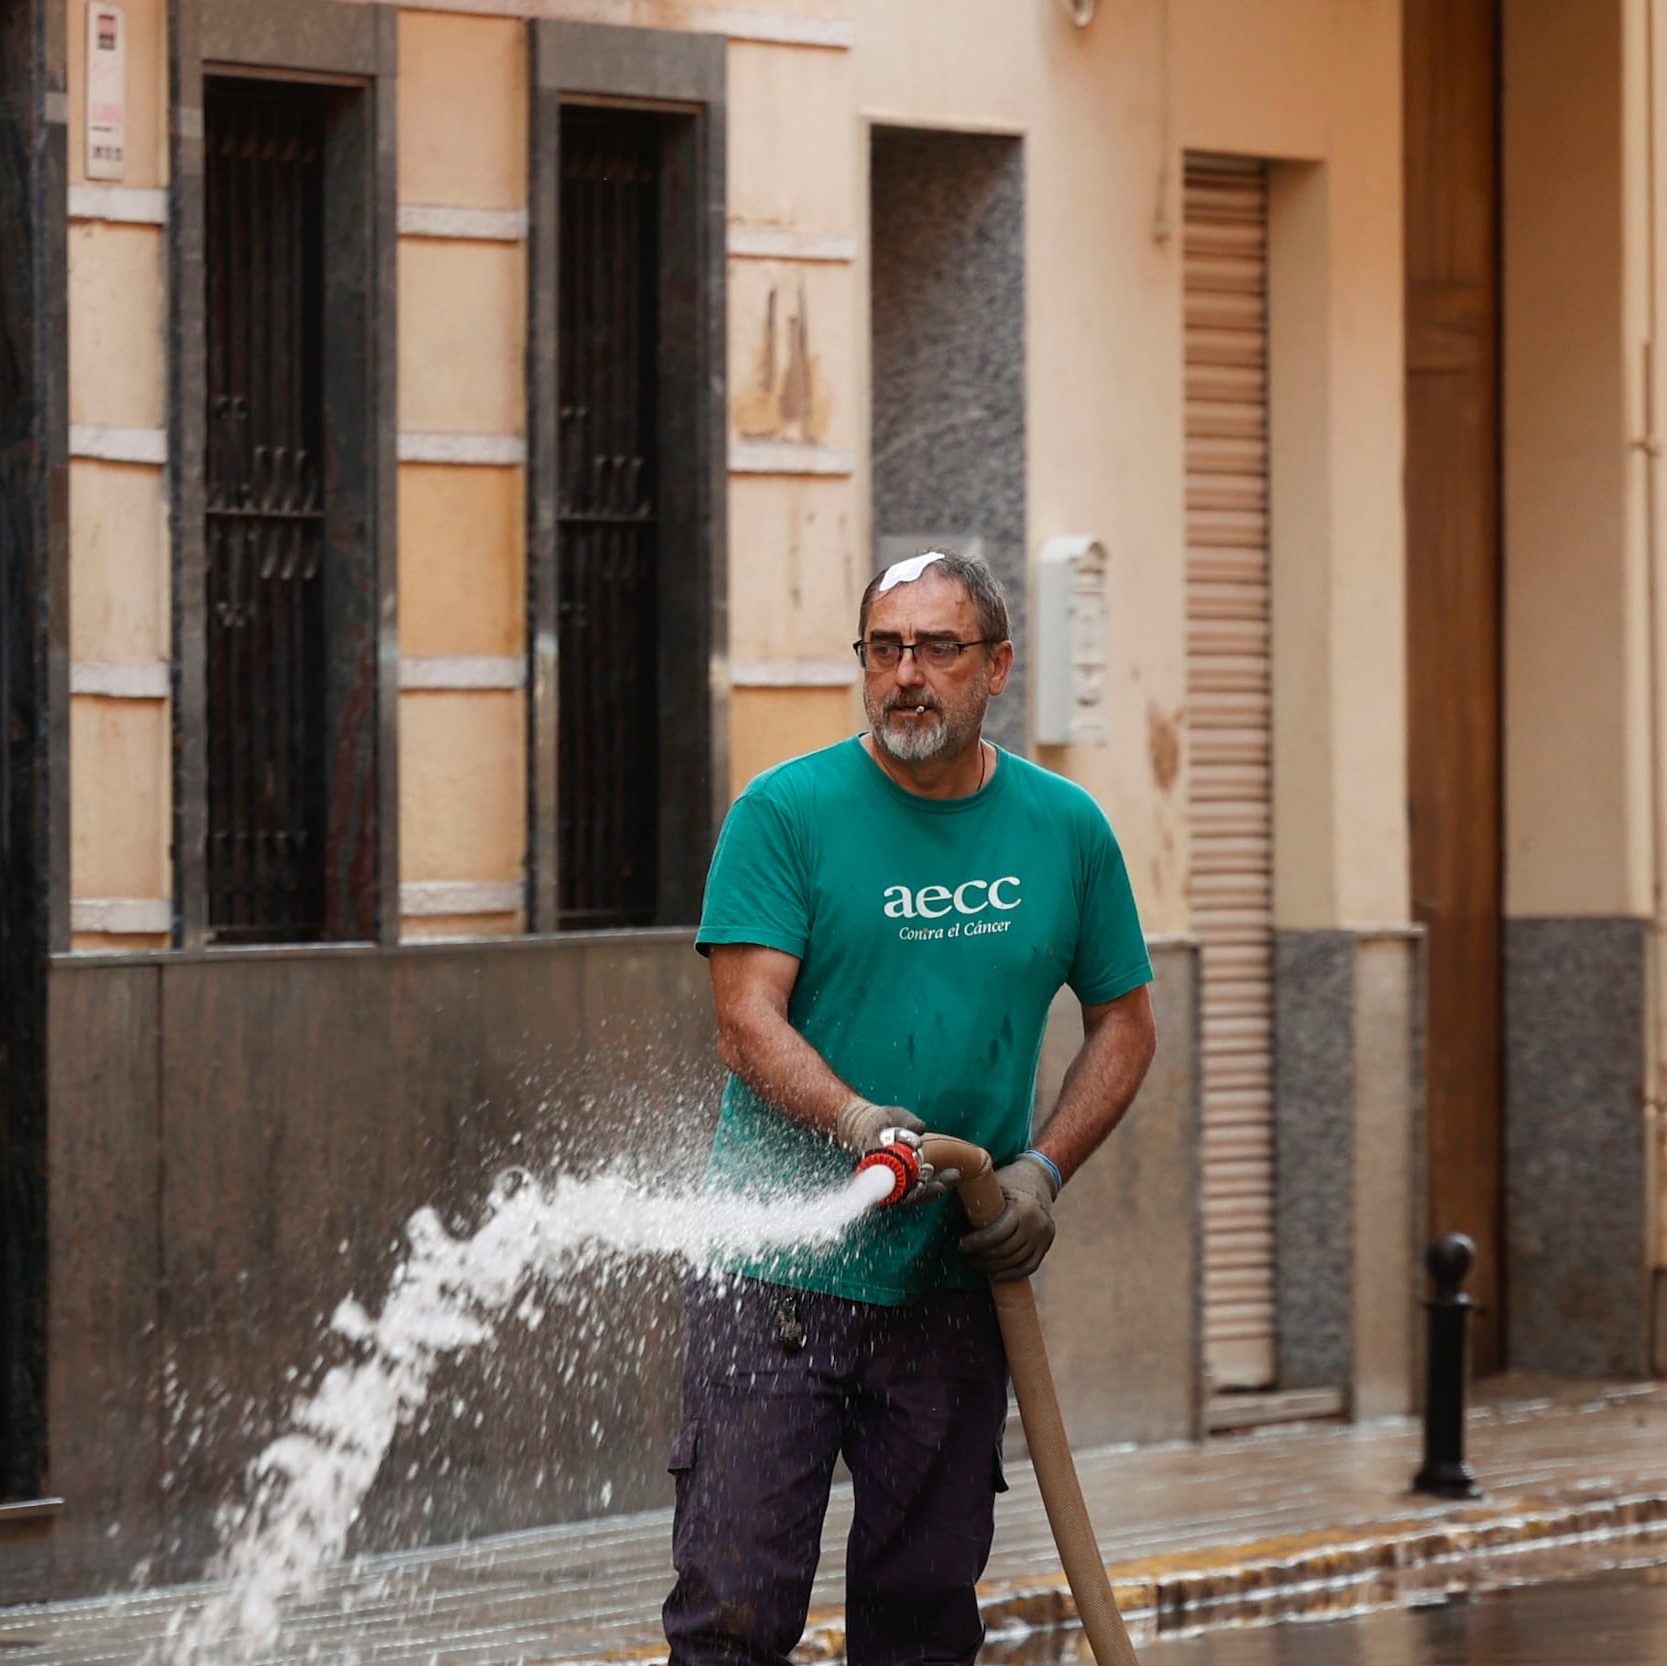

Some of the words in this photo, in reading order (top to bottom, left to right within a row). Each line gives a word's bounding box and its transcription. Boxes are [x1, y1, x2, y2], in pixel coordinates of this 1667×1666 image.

[883, 876, 1022, 919] aecc
[899, 926, 944, 940] Contra
[947, 923, 960, 937] el
[964, 920, 1011, 936] Cáncer
